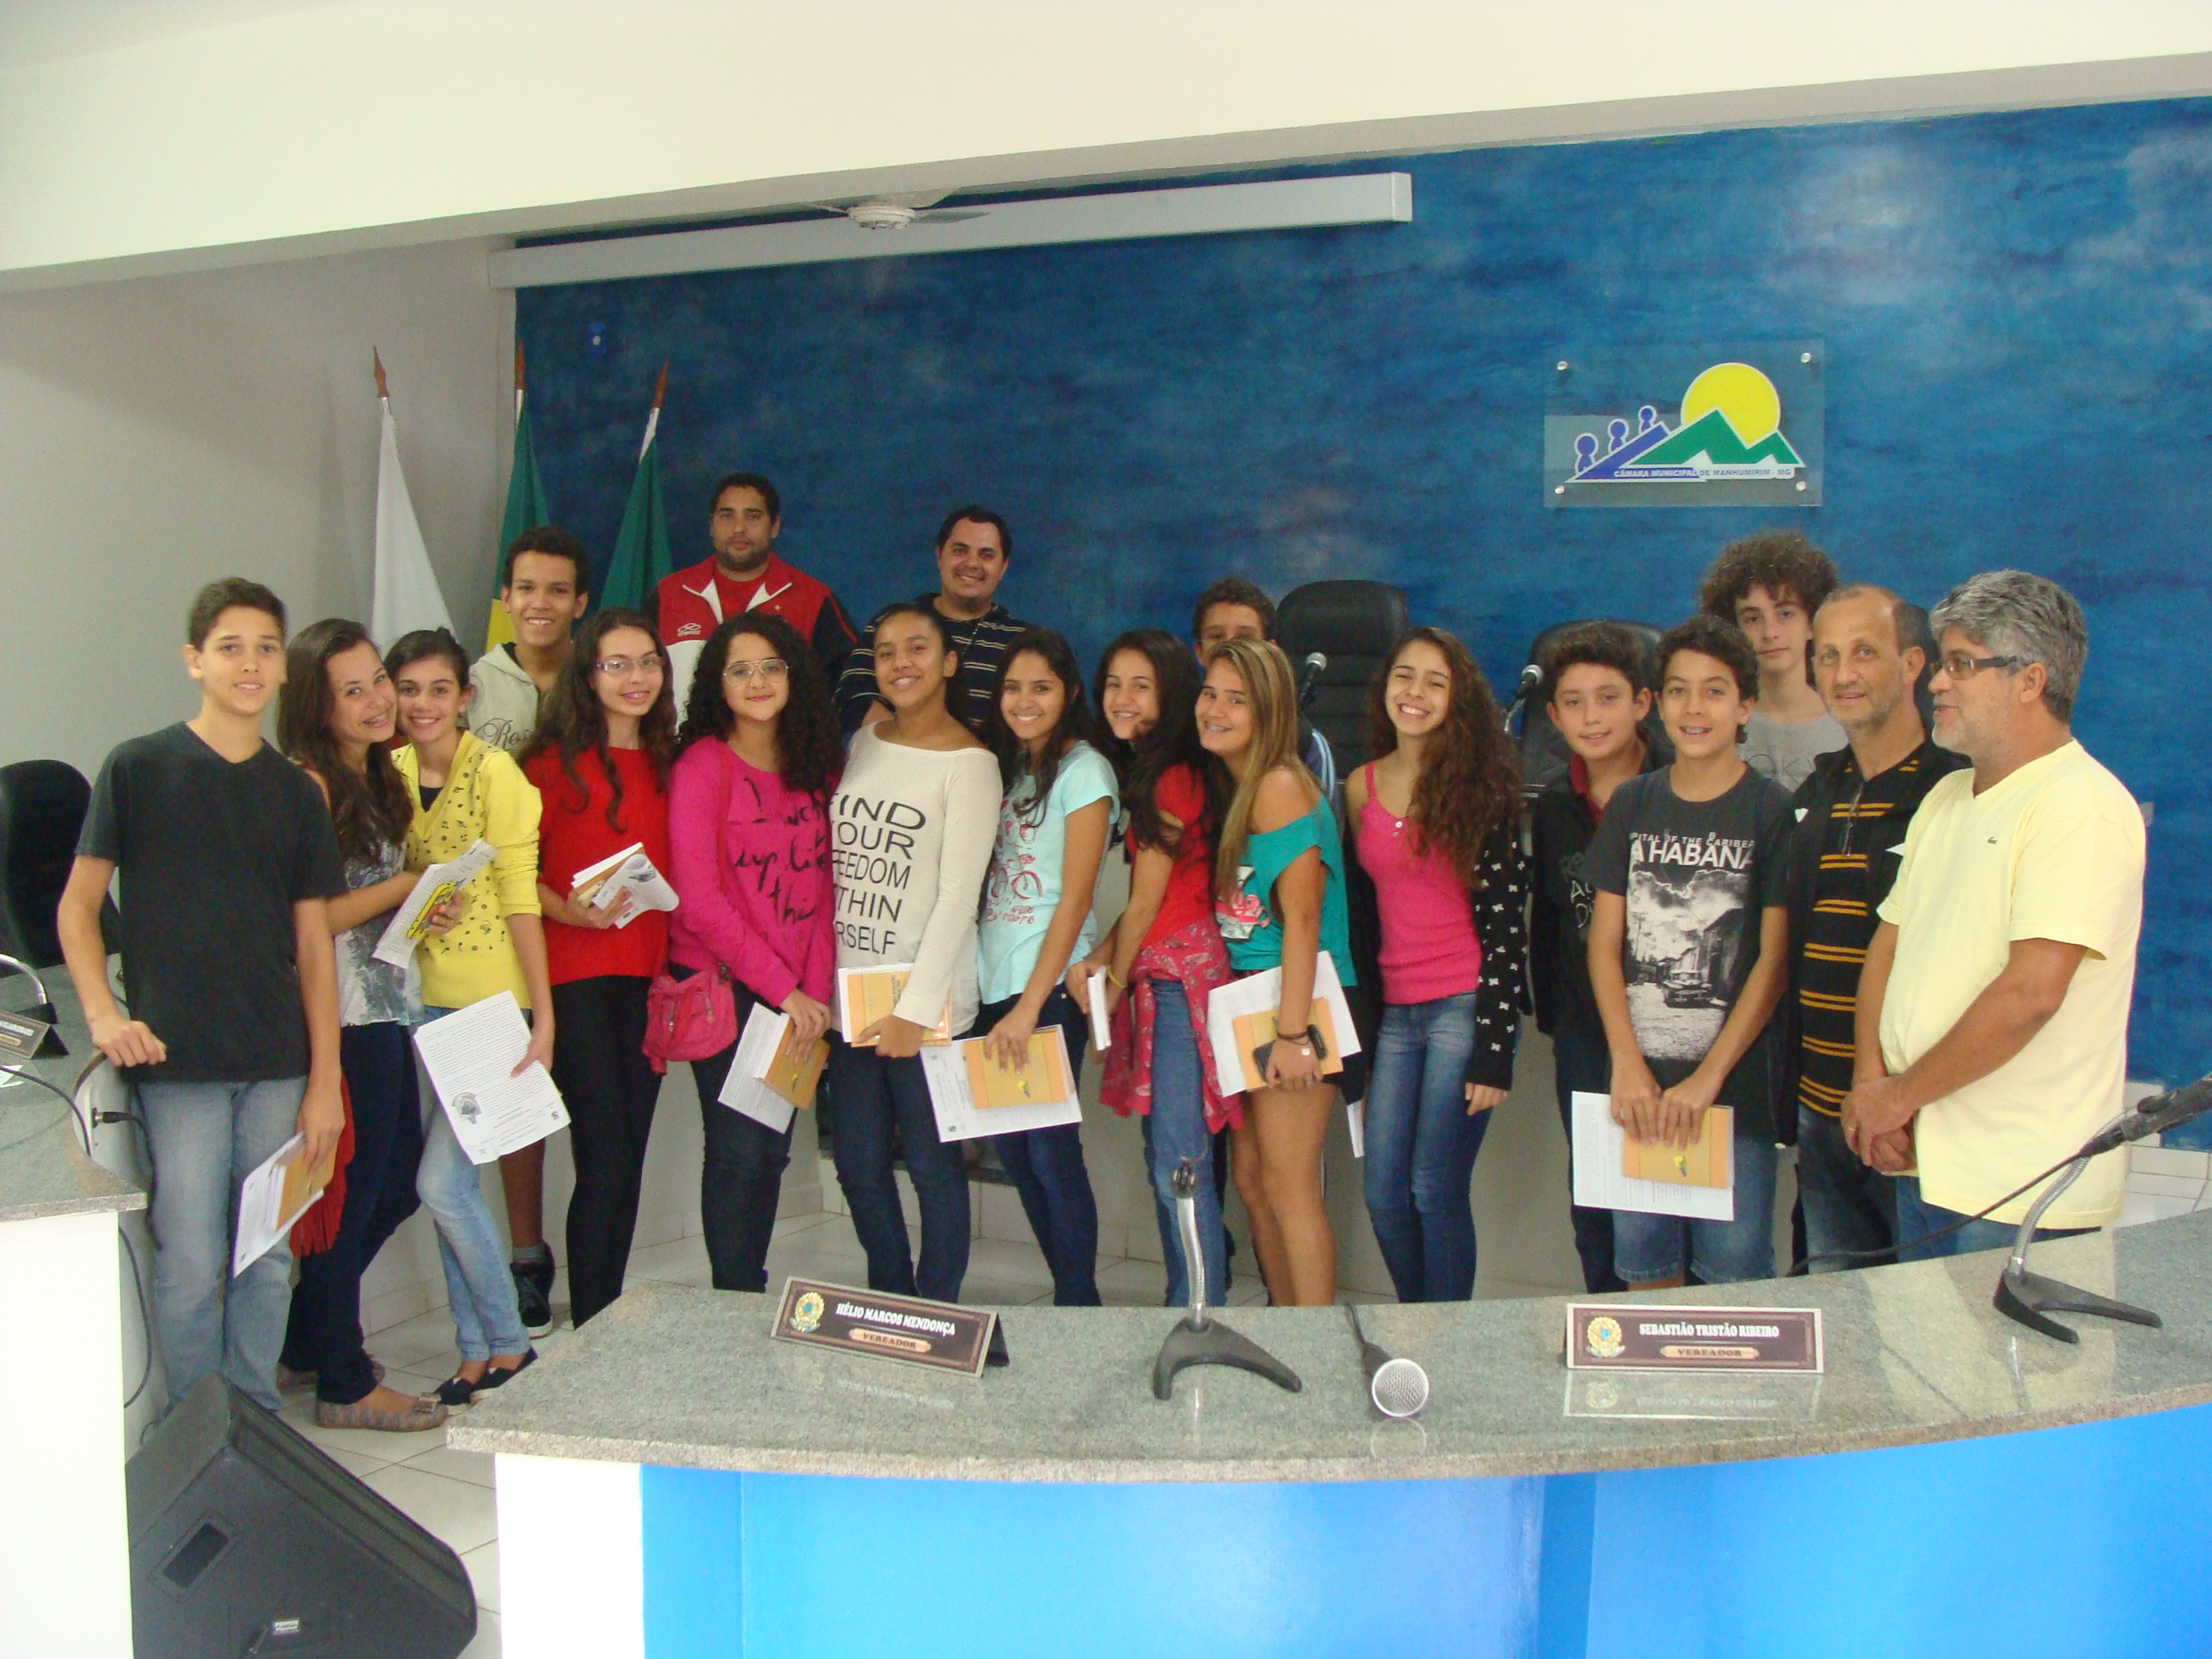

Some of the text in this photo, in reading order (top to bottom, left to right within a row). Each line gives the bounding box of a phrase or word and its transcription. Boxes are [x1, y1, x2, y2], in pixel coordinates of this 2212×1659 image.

[1650, 469, 1697, 478] MUNICIPAL
[832, 820, 915, 860] OUR
[1681, 836, 1703, 846] THE
[1648, 841, 1753, 870] HABANA
[835, 1301, 956, 1337] HÉLIO MARCOS MENDONÇA
[1639, 1321, 1780, 1337] SEBASTIÃO TRISTÃO RIBEIRO
[863, 1332, 917, 1348] VEREADOR
[1678, 1348, 1743, 1357] VEREADOR
